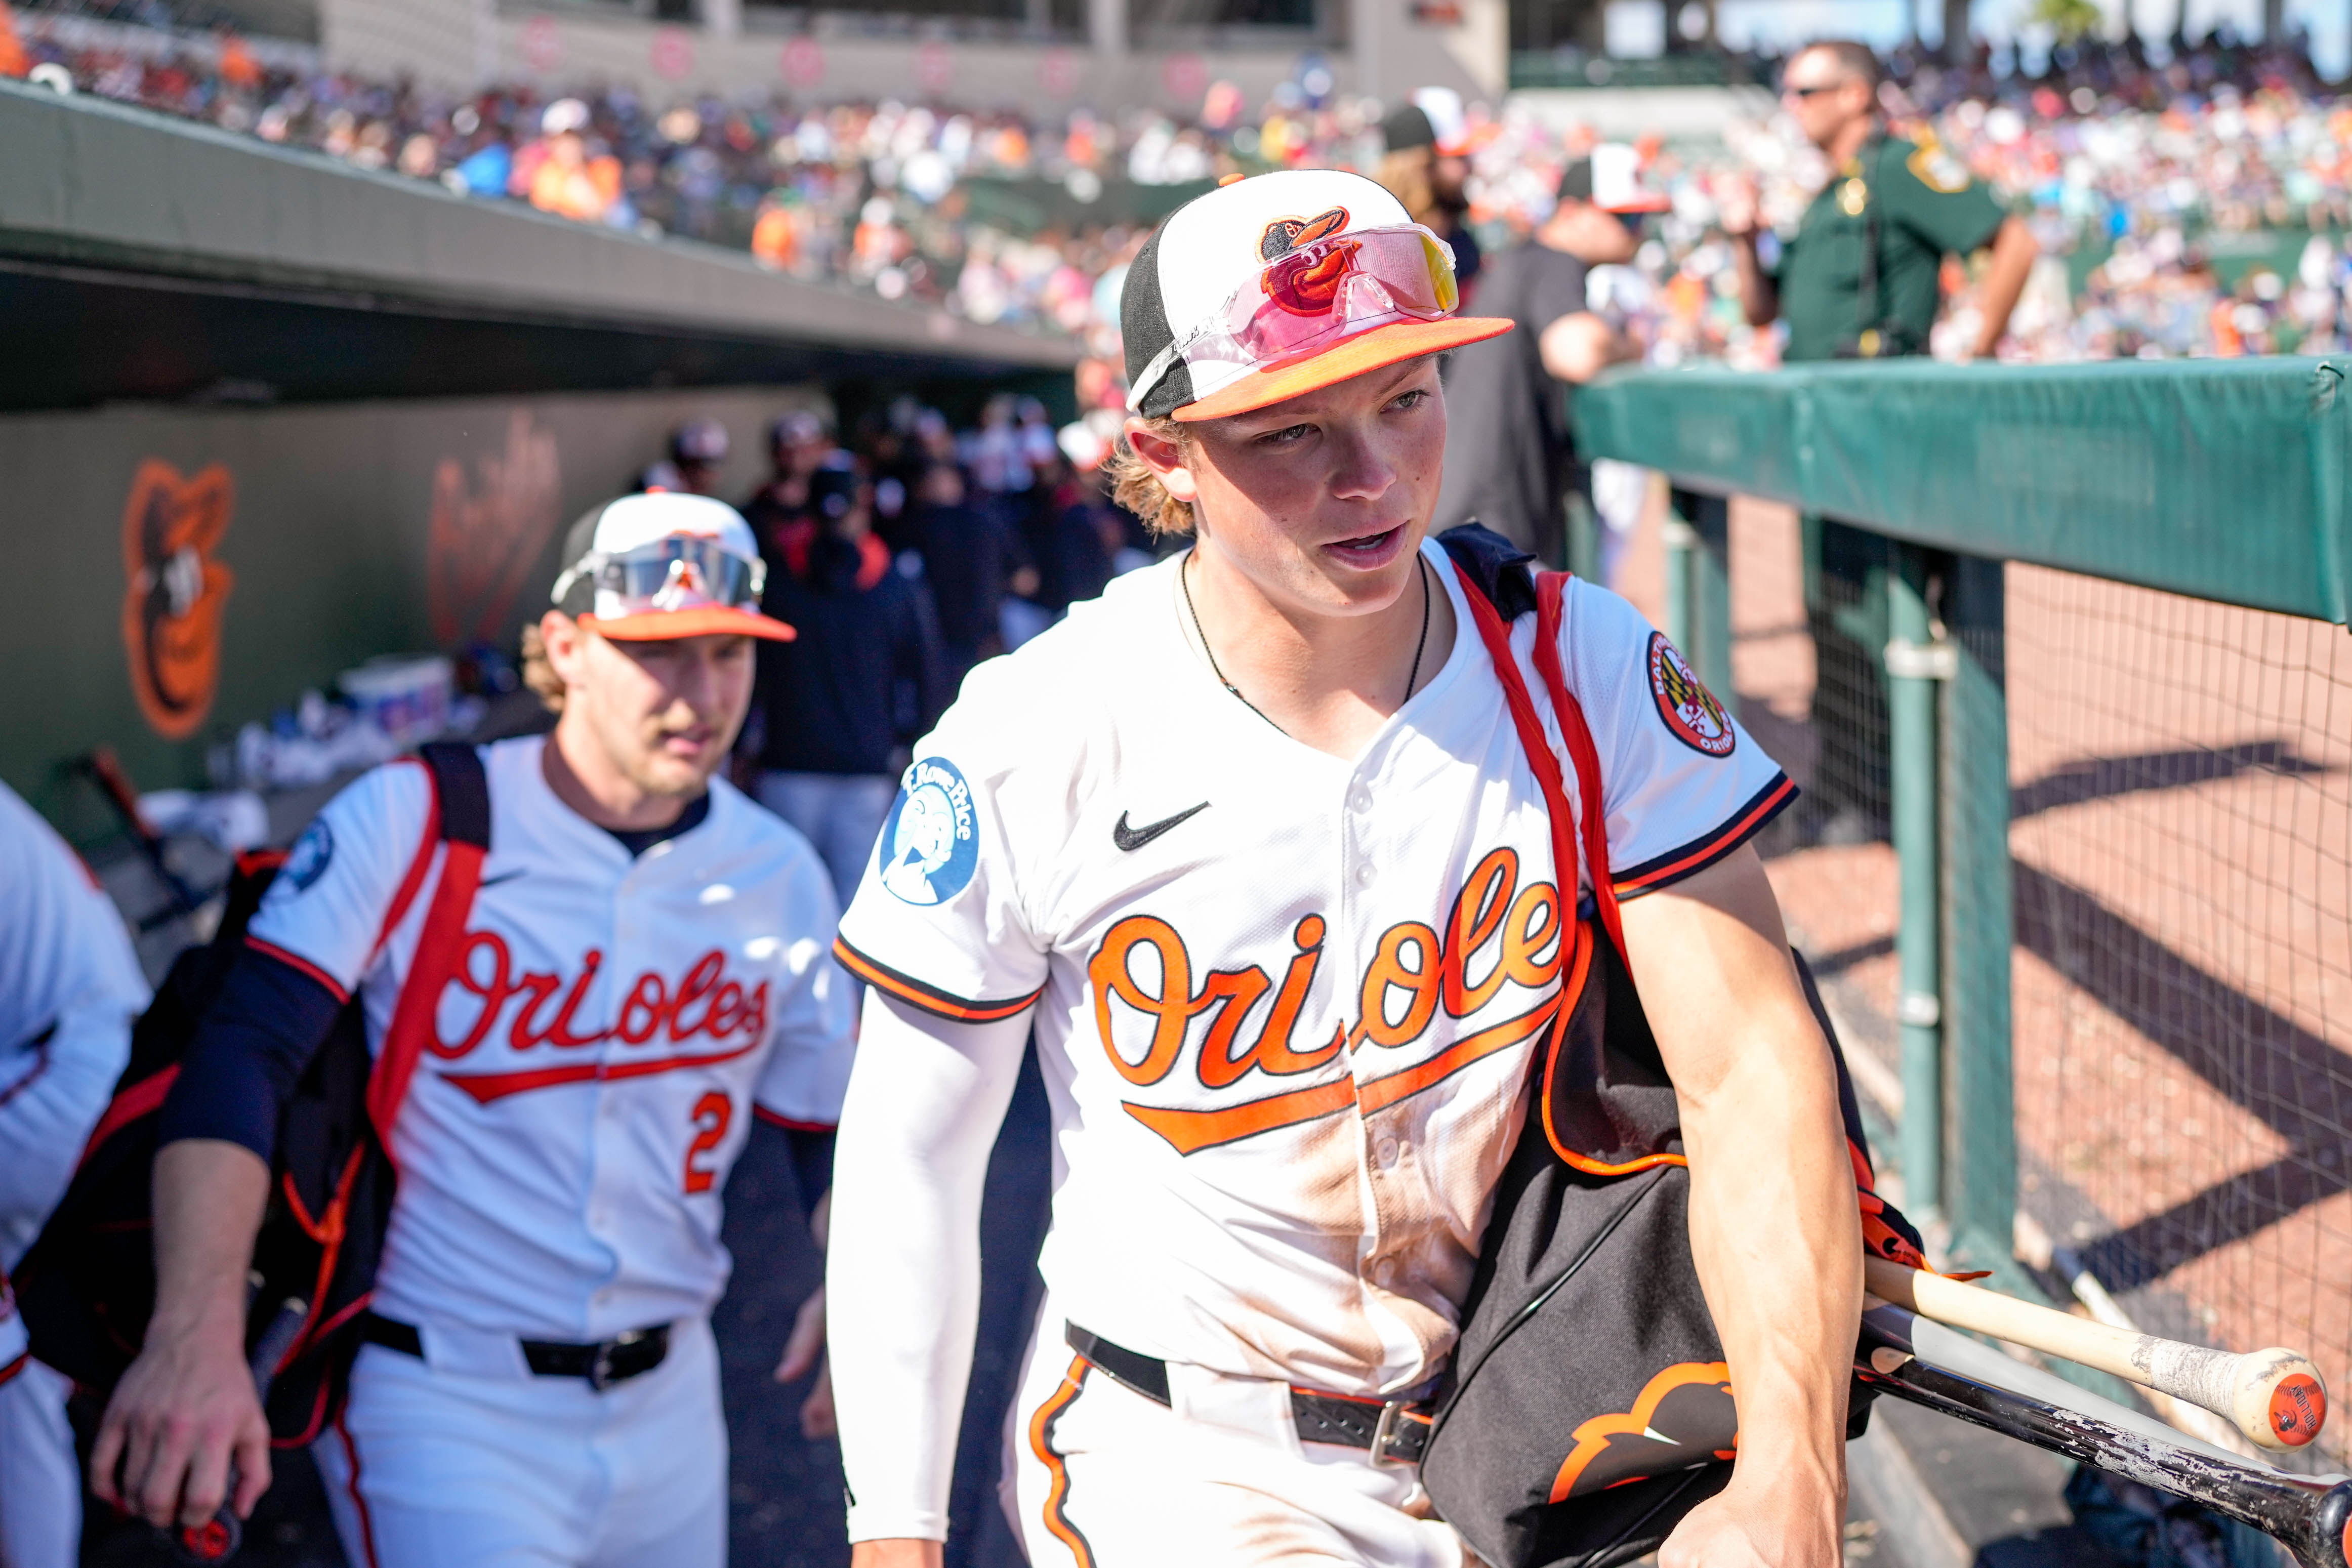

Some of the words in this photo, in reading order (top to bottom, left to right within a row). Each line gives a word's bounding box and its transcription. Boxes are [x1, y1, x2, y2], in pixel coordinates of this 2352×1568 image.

[426, 930, 770, 1060] Orioles
[1088, 846, 1562, 1089] Oriole
[685, 1090, 732, 1195] 2
[2291, 1384, 2318, 1430] HOLLIDAY
